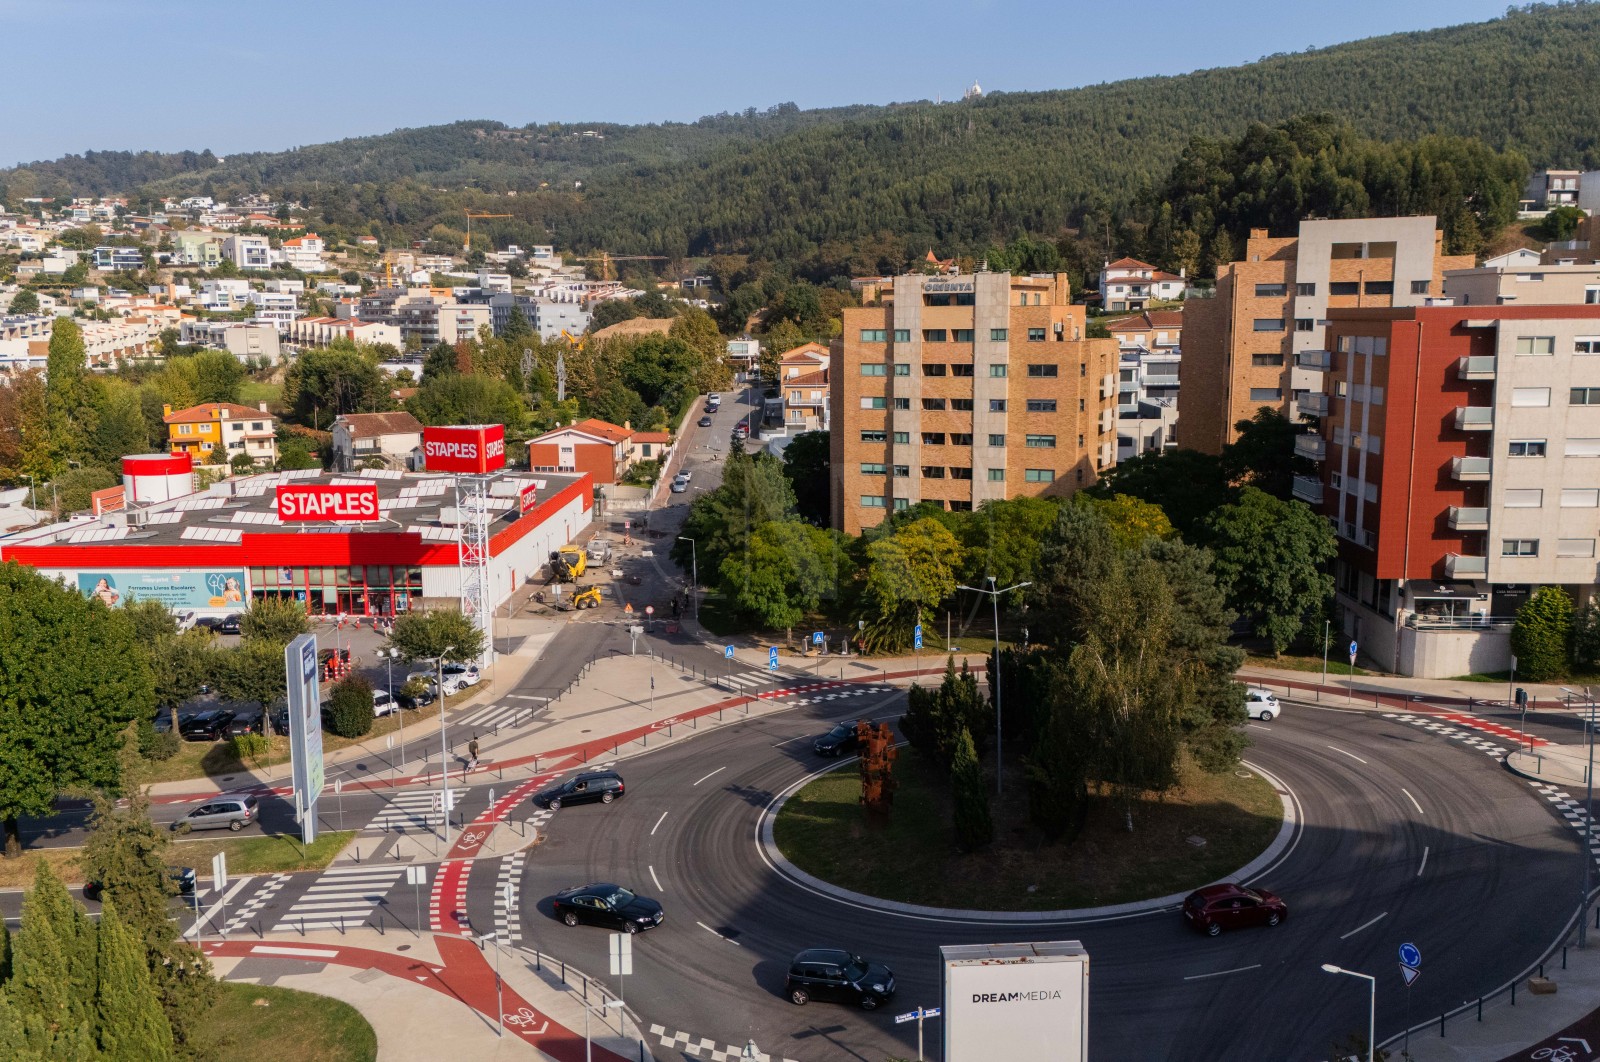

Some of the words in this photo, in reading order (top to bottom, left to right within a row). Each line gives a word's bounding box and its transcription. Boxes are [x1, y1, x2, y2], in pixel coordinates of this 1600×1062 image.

[426, 441, 477, 459] STAPLES
[486, 438, 504, 459] STAPLES
[281, 492, 375, 516] STAPLES
[523, 489, 536, 507] STAPLES
[972, 990, 1062, 1004] DREAMMEDIA
